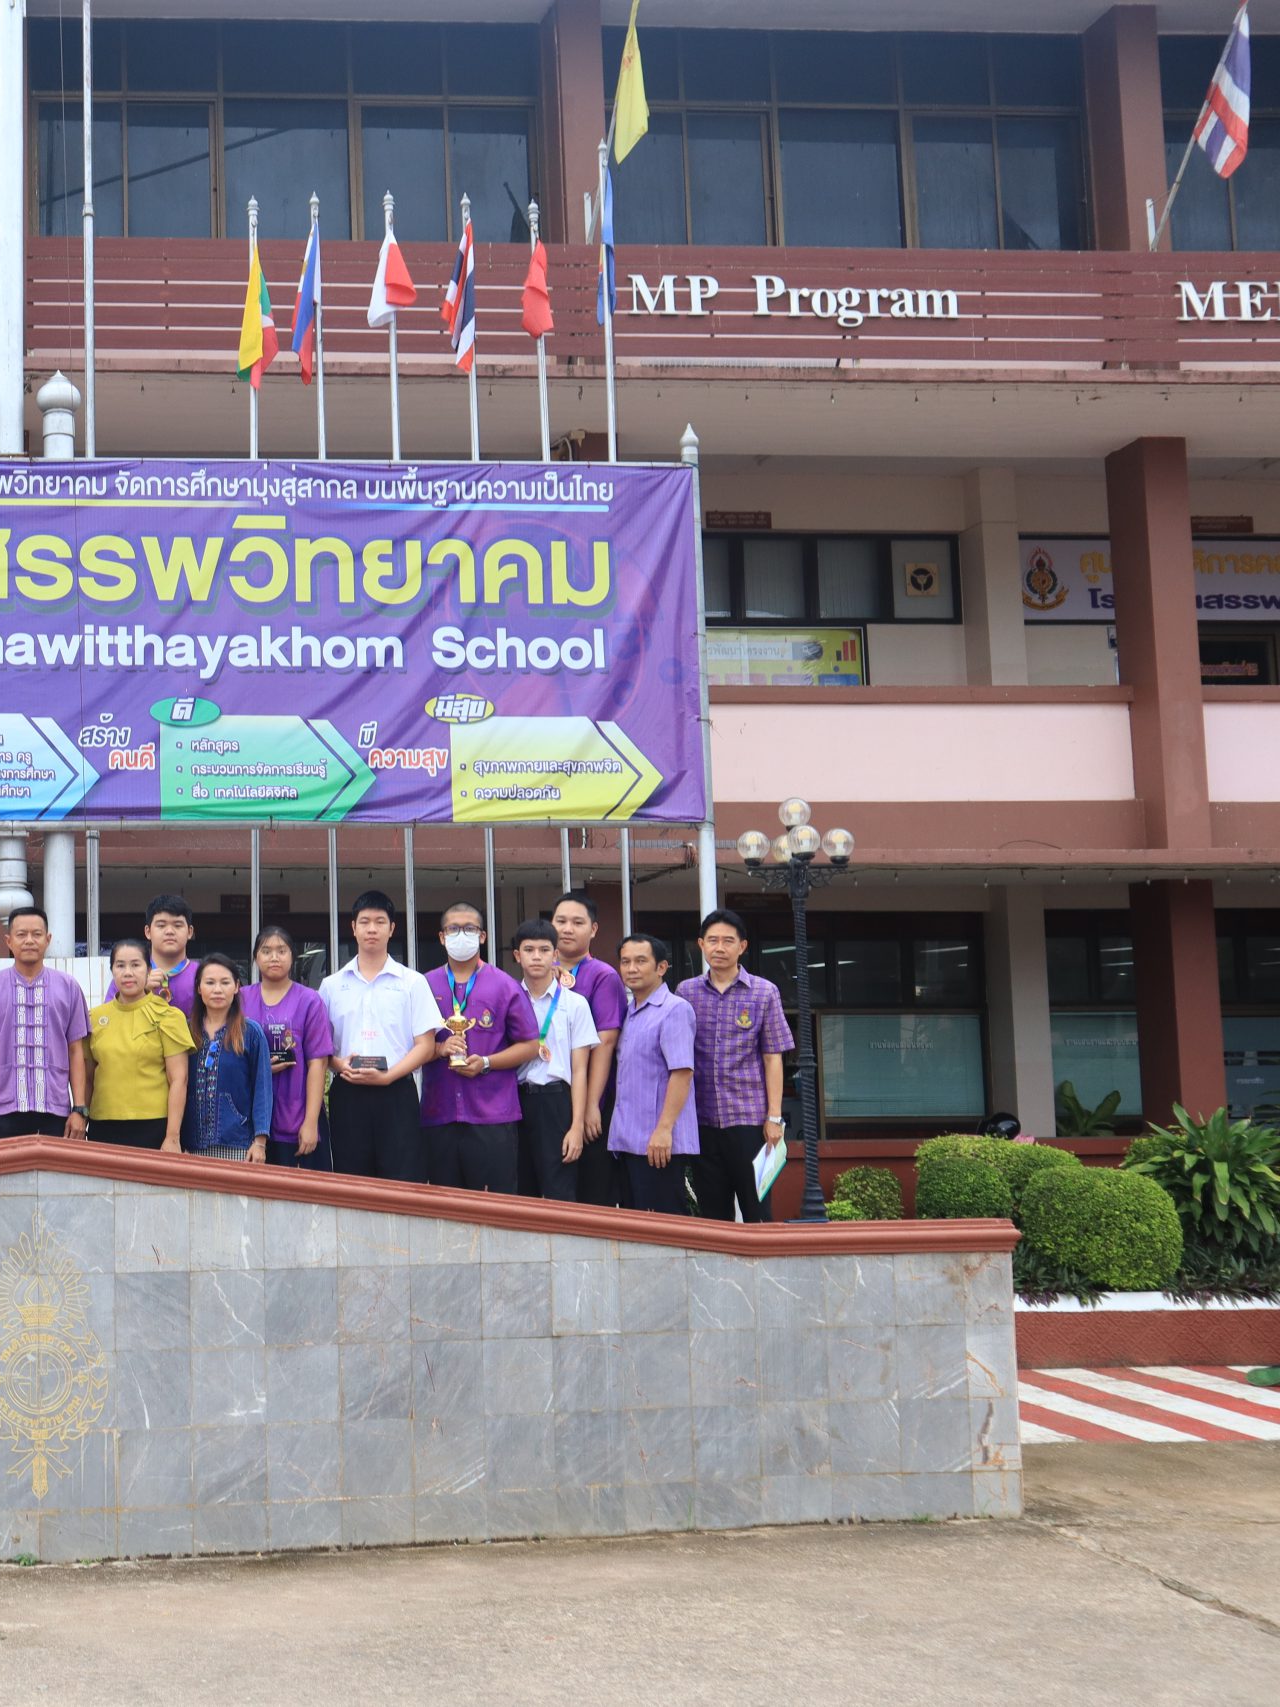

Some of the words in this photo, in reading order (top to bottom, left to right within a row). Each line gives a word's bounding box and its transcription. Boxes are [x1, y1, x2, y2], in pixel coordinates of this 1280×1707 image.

[628, 274, 720, 316] MP
[752, 274, 960, 328] Program
[1176, 281, 1280, 322] ME
[114, 463, 358, 506] จัดการศึกษามุ่งสู่สากล
[364, 466, 614, 507] บนพื้นฐานความเป็นไทย
[431, 627, 606, 671] School
[79, 713, 131, 747] สร้าง
[191, 738, 239, 755] หลักสูตร
[358, 721, 377, 748] มี
[109, 743, 155, 770] คนดี
[369, 748, 449, 776] ความสุข
